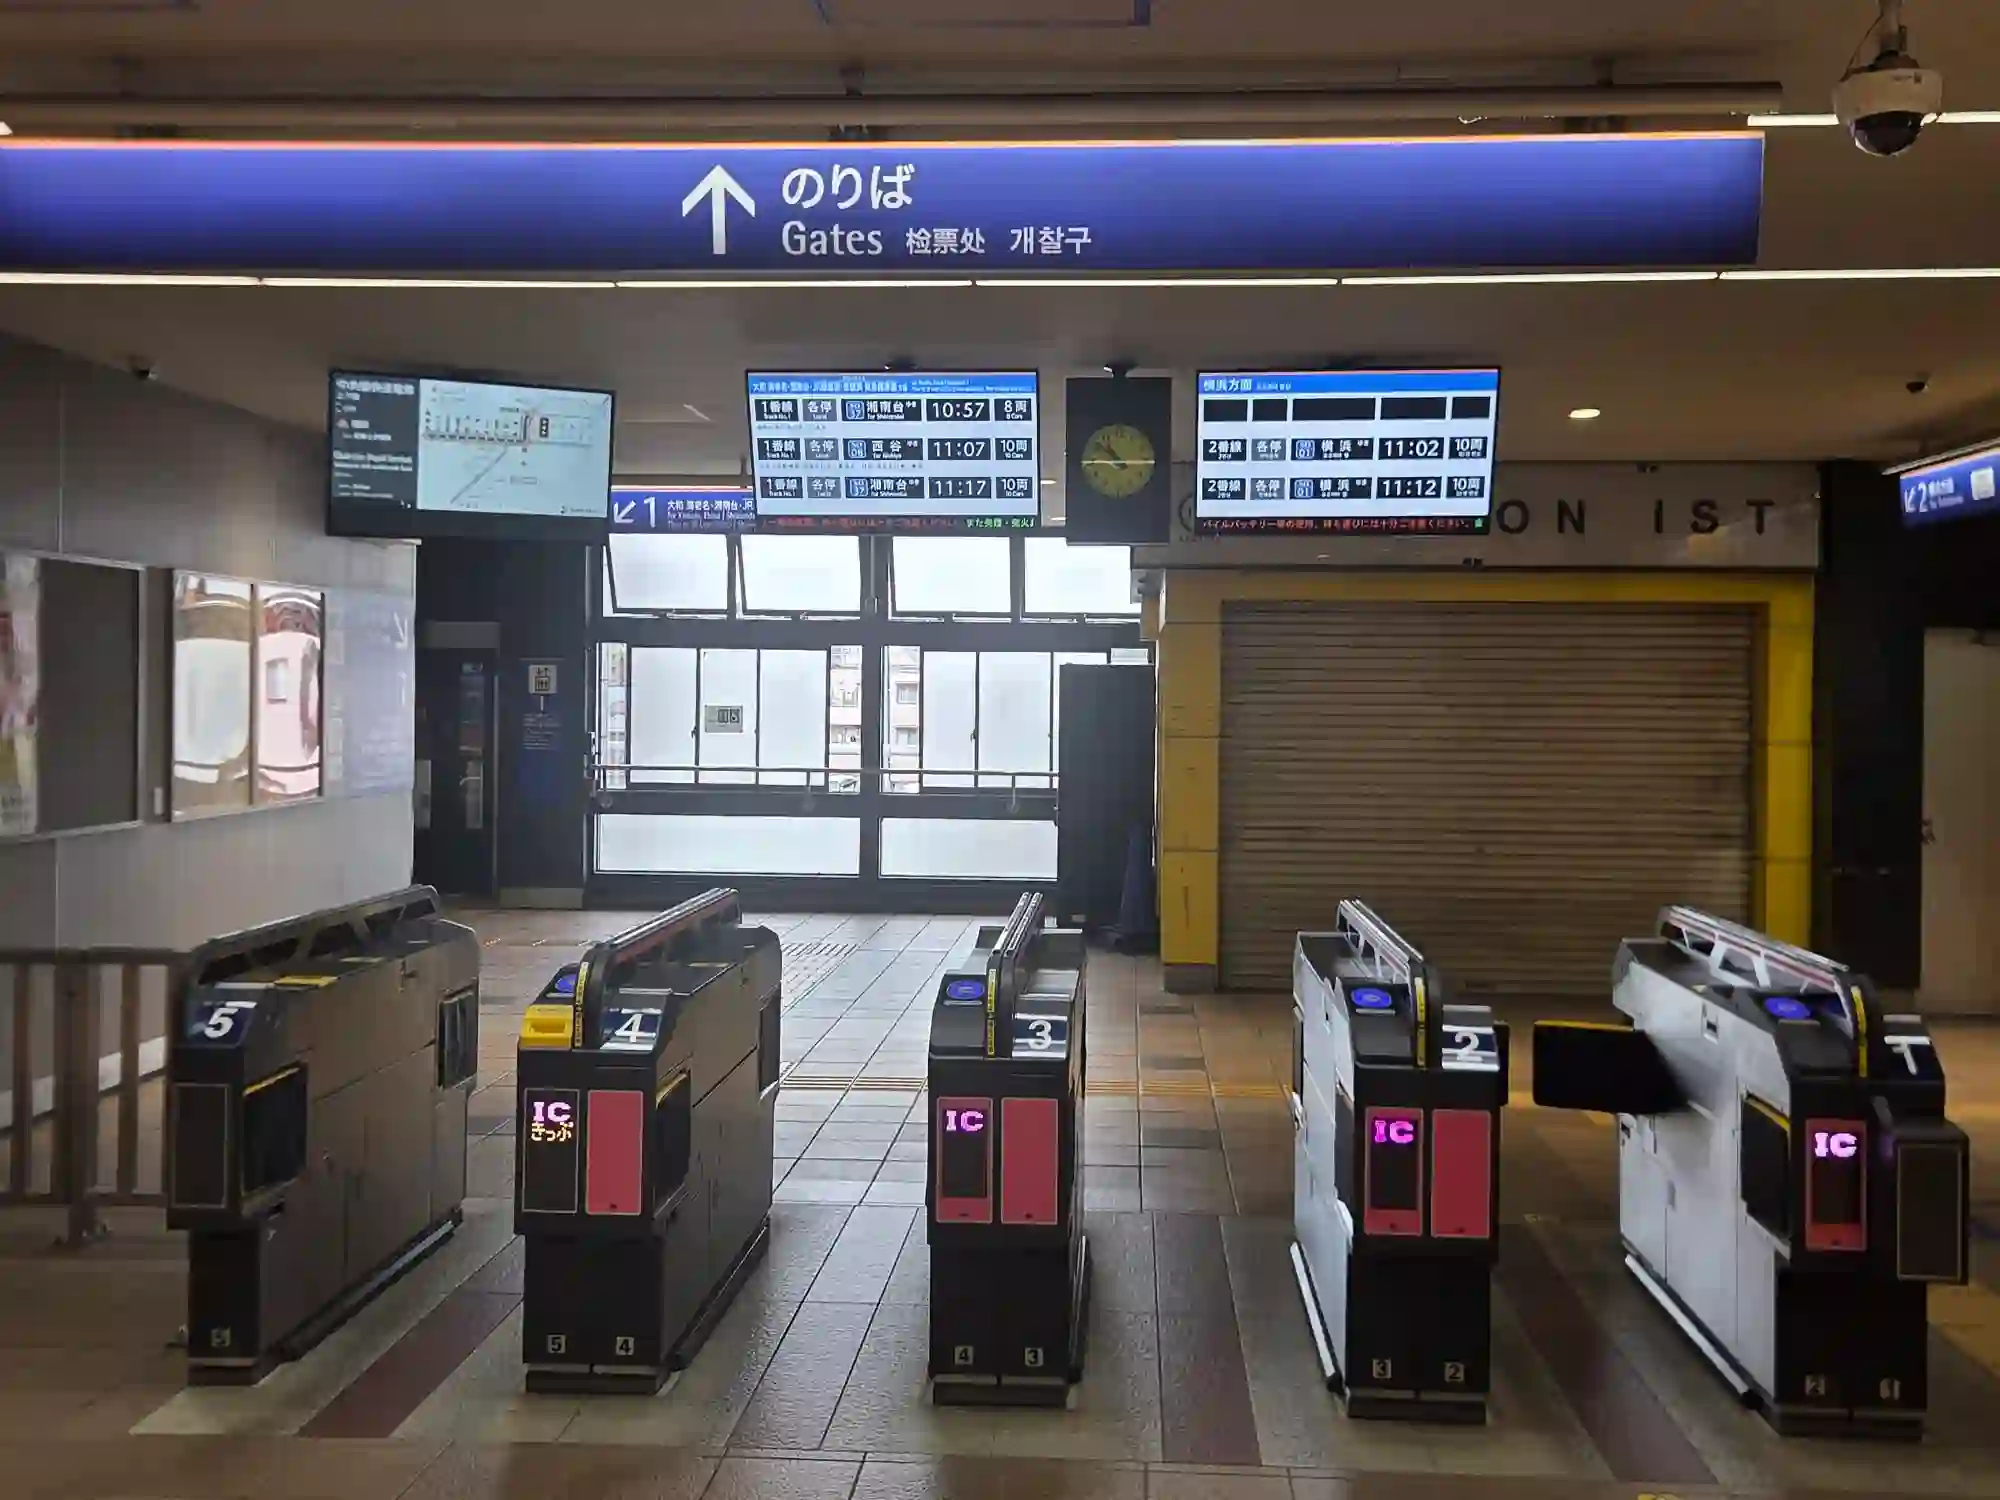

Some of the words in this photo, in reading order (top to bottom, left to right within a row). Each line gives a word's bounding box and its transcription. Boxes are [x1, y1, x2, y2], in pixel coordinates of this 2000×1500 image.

[780, 163, 915, 210] のりば
[781, 220, 884, 256] Gates
[904, 226, 986, 255] 检票处
[1009, 225, 1092, 255] 개찰구
[762, 401, 793, 413] 1番線
[808, 401, 832, 413] 各停
[866, 401, 904, 414] 湘南台
[932, 402, 985, 418] 10:57
[1003, 400, 1028, 413] 8両
[764, 440, 795, 452] 1番線
[810, 440, 834, 452] 各停
[934, 441, 985, 458] 11:07
[1000, 439, 1028, 453] 10両
[1208, 440, 1242, 454] 2番線
[1256, 440, 1282, 454] 各停
[1320, 440, 1352, 453] 横浜
[1384, 440, 1440, 457] 11:02
[766, 478, 798, 491] 1番線
[812, 478, 836, 491] 各停
[869, 478, 907, 491] 湘南台
[935, 480, 987, 496] 11:17
[1001, 478, 1029, 491] 10両
[1207, 479, 1241, 493] 2番線
[1255, 479, 1281, 493] 各停
[1319, 479, 1350, 492] 横浜
[1382, 479, 1437, 497] 11:12
[1917, 481, 1929, 513] 2
[643, 496, 656, 528] 1
[1652, 499, 1777, 537] IST
[203, 1006, 238, 1040] 5
[614, 1013, 657, 1043] 4
[1028, 1019, 1053, 1050] 3
[1454, 1030, 1484, 1062] 2
[531, 1100, 572, 1122] IC
[944, 1109, 985, 1132] IC
[530, 1121, 574, 1142] きっぷ
[1374, 1119, 1414, 1144] IC
[1814, 1131, 1858, 1157] IC
